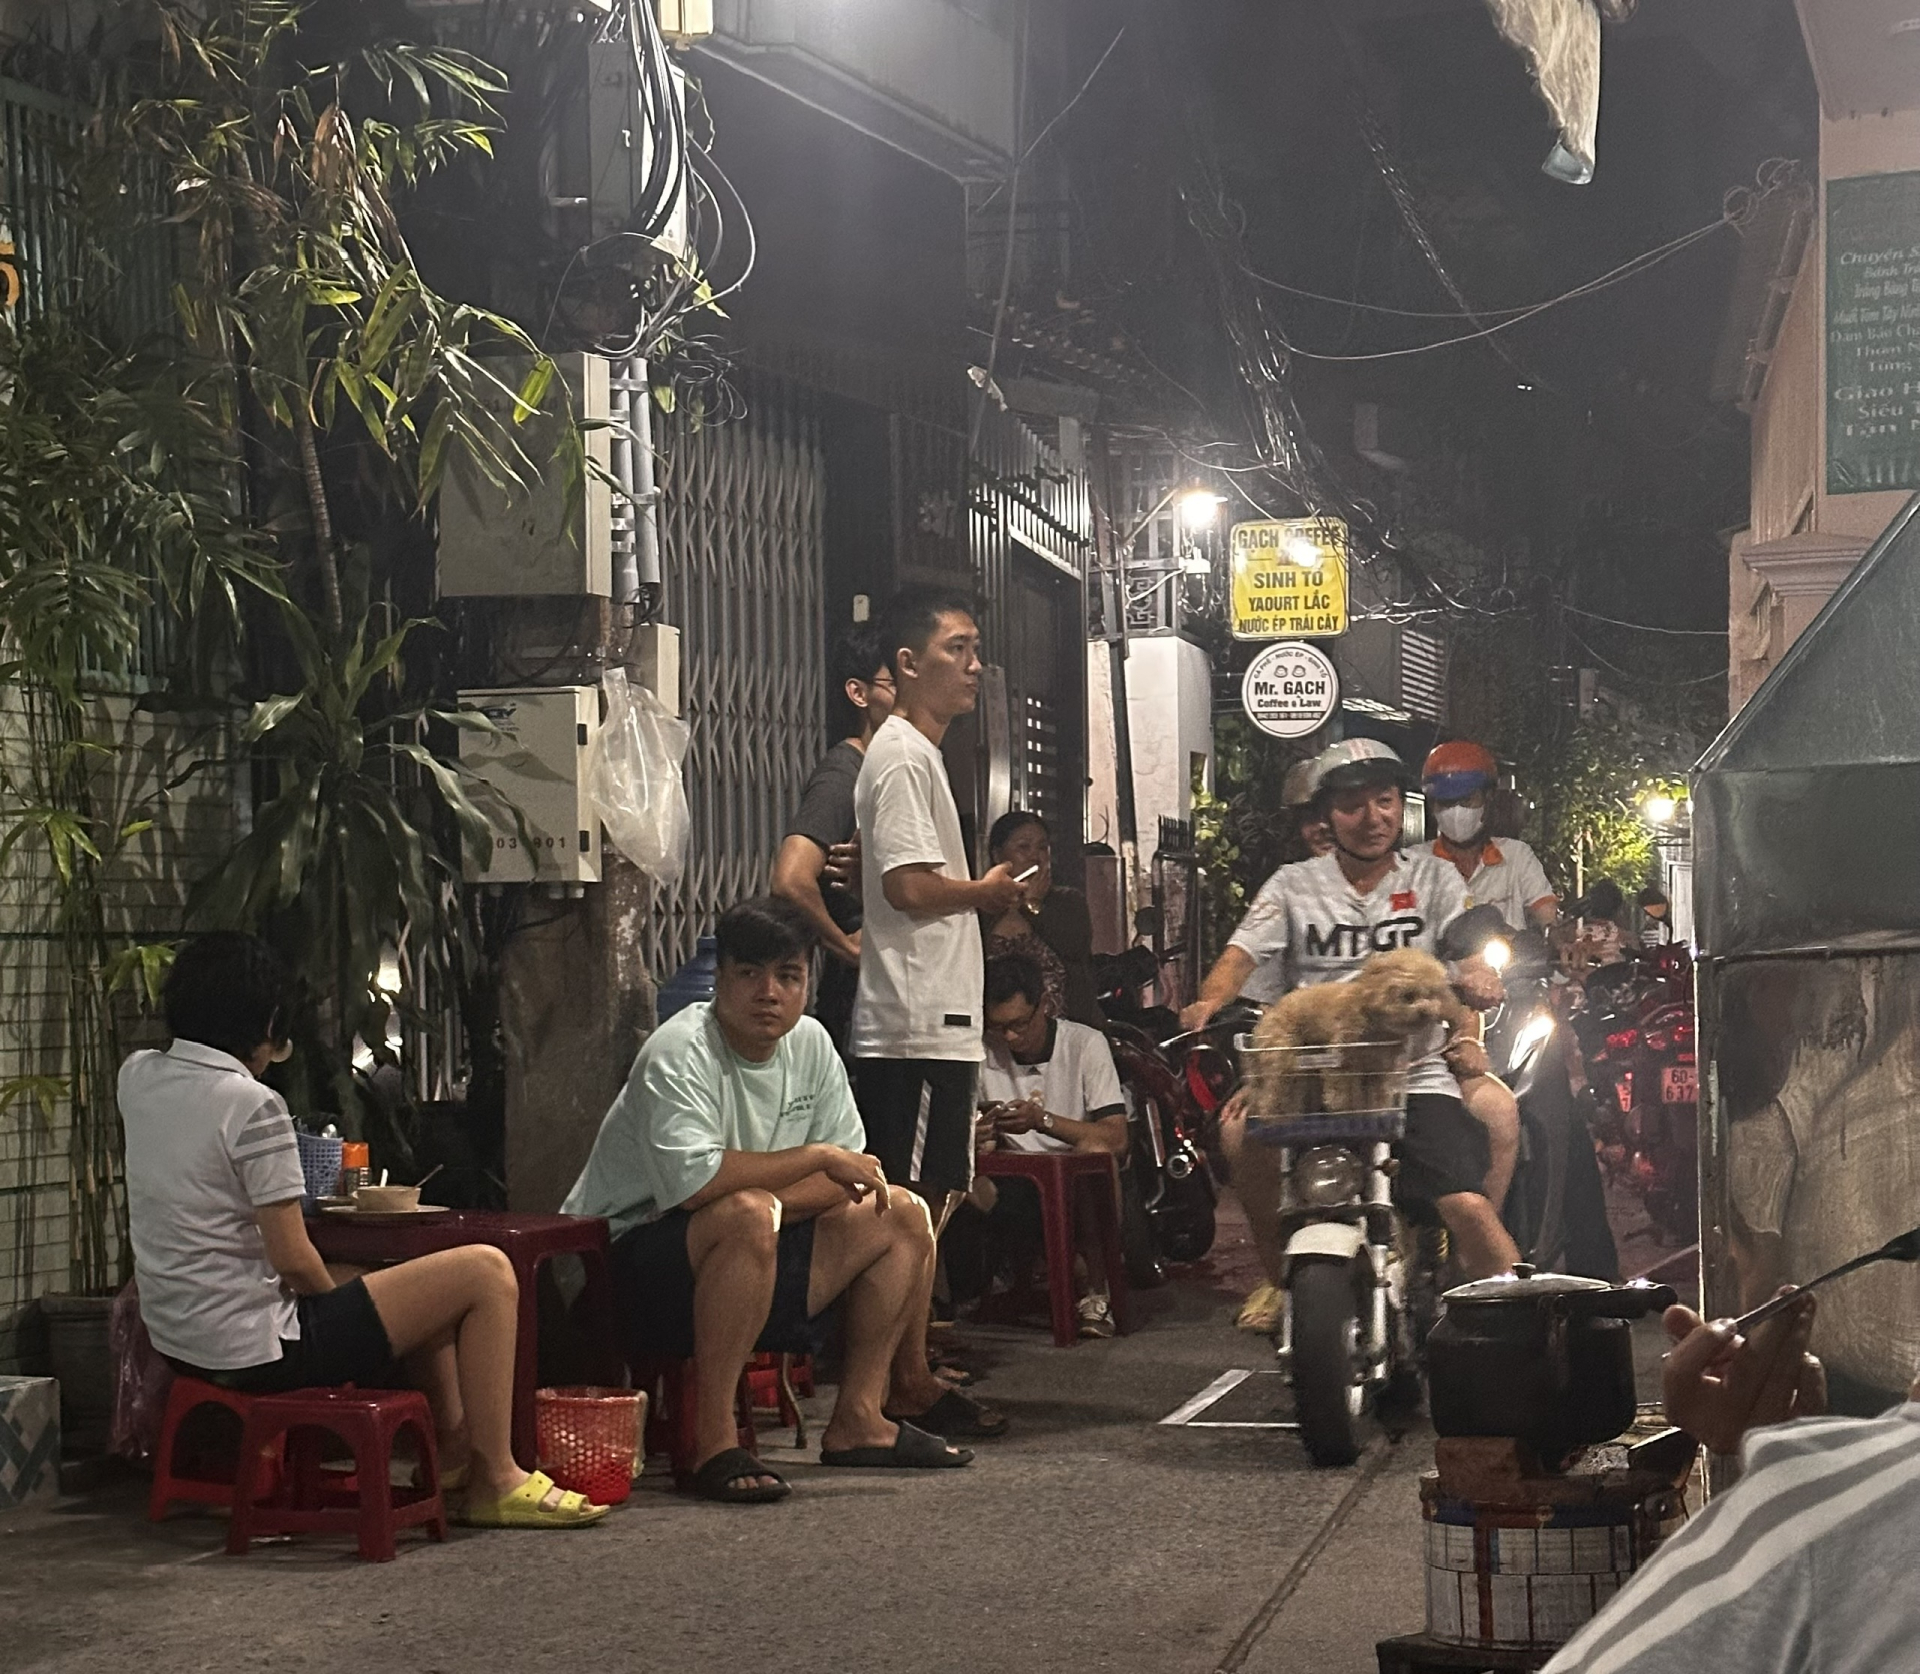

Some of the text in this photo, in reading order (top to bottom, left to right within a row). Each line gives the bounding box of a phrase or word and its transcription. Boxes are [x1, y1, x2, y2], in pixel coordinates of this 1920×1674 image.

[1238, 529, 1279, 553] GẠCH
[1254, 571, 1296, 589] SINH
[1248, 589, 1330, 612] YAOURT LẮC
[1272, 615, 1286, 632] ÉP
[1290, 613, 1314, 631] TRÁI
[1317, 613, 1339, 631] CÂY
[1254, 681, 1279, 696] Mr.
[1257, 699, 1289, 708] Coffee
[1299, 698, 1321, 708] Law
